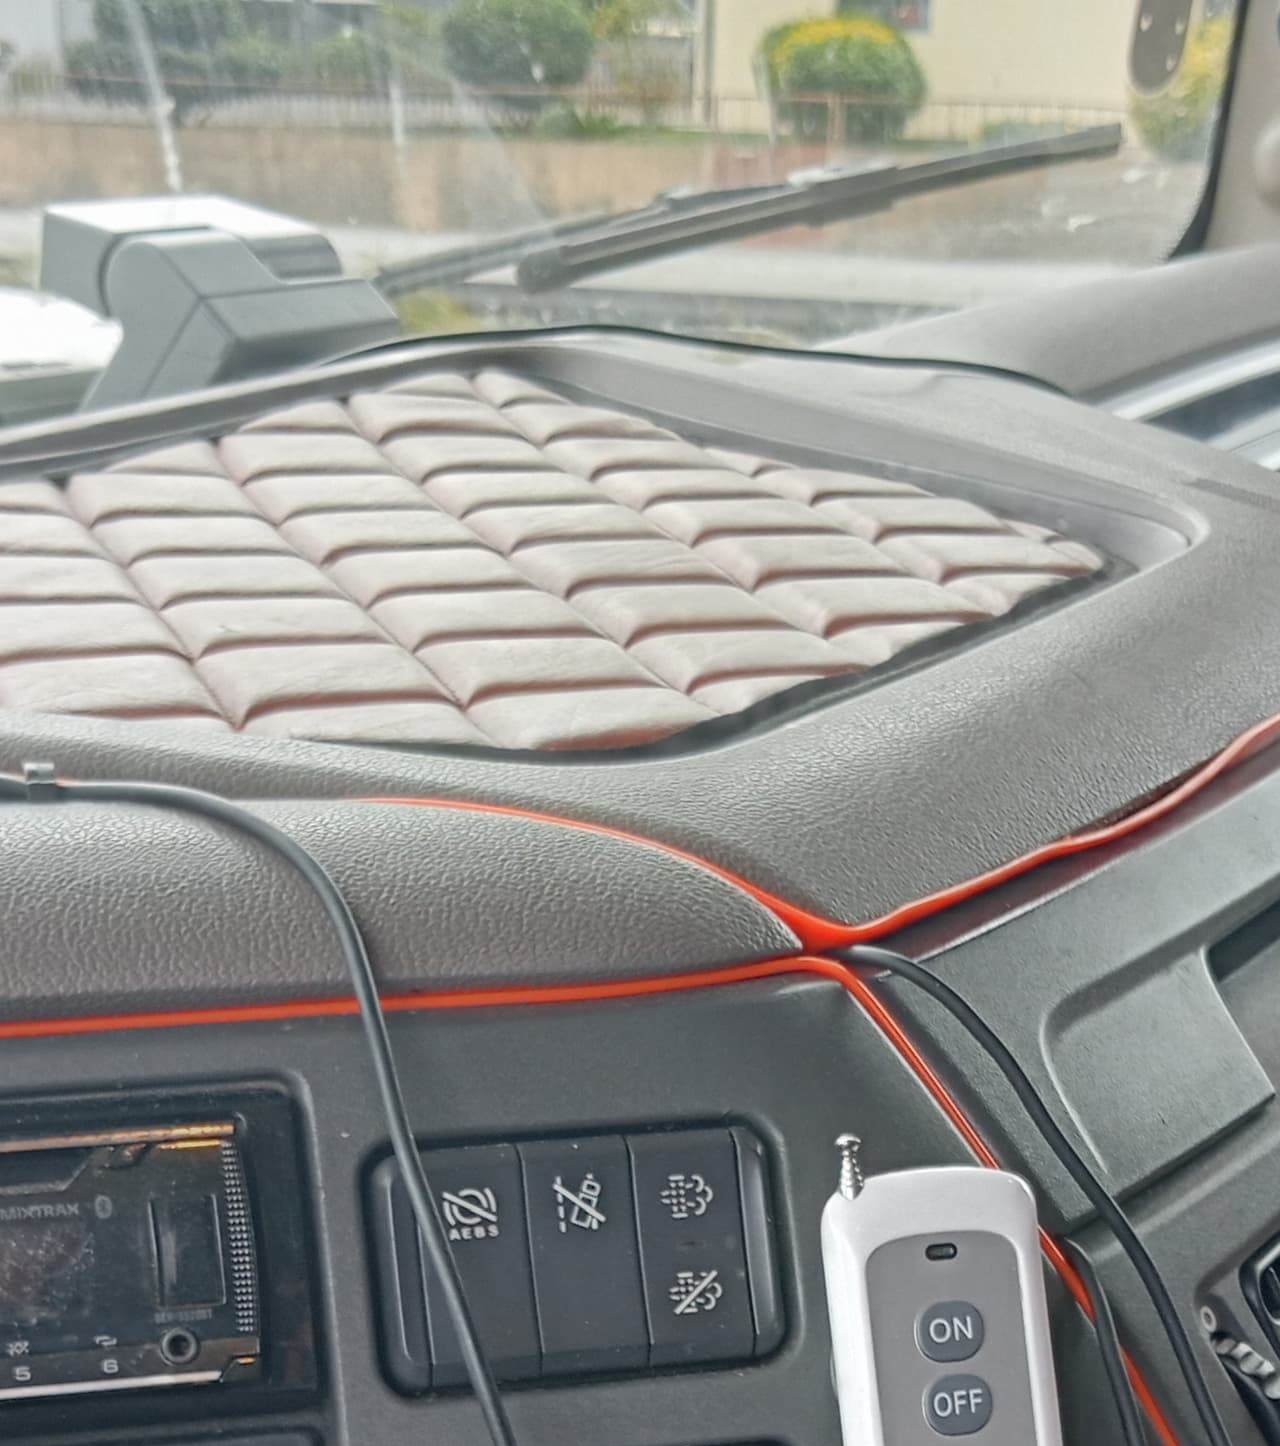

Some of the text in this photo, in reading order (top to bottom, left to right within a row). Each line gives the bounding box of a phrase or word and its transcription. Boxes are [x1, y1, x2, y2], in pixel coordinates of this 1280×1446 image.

[449, 1223, 500, 1241] AEBS
[928, 1316, 974, 1343] ON
[14, 1364, 32, 1382] 5
[102, 1356, 120, 1375] 6
[932, 1388, 984, 1418] OFF
